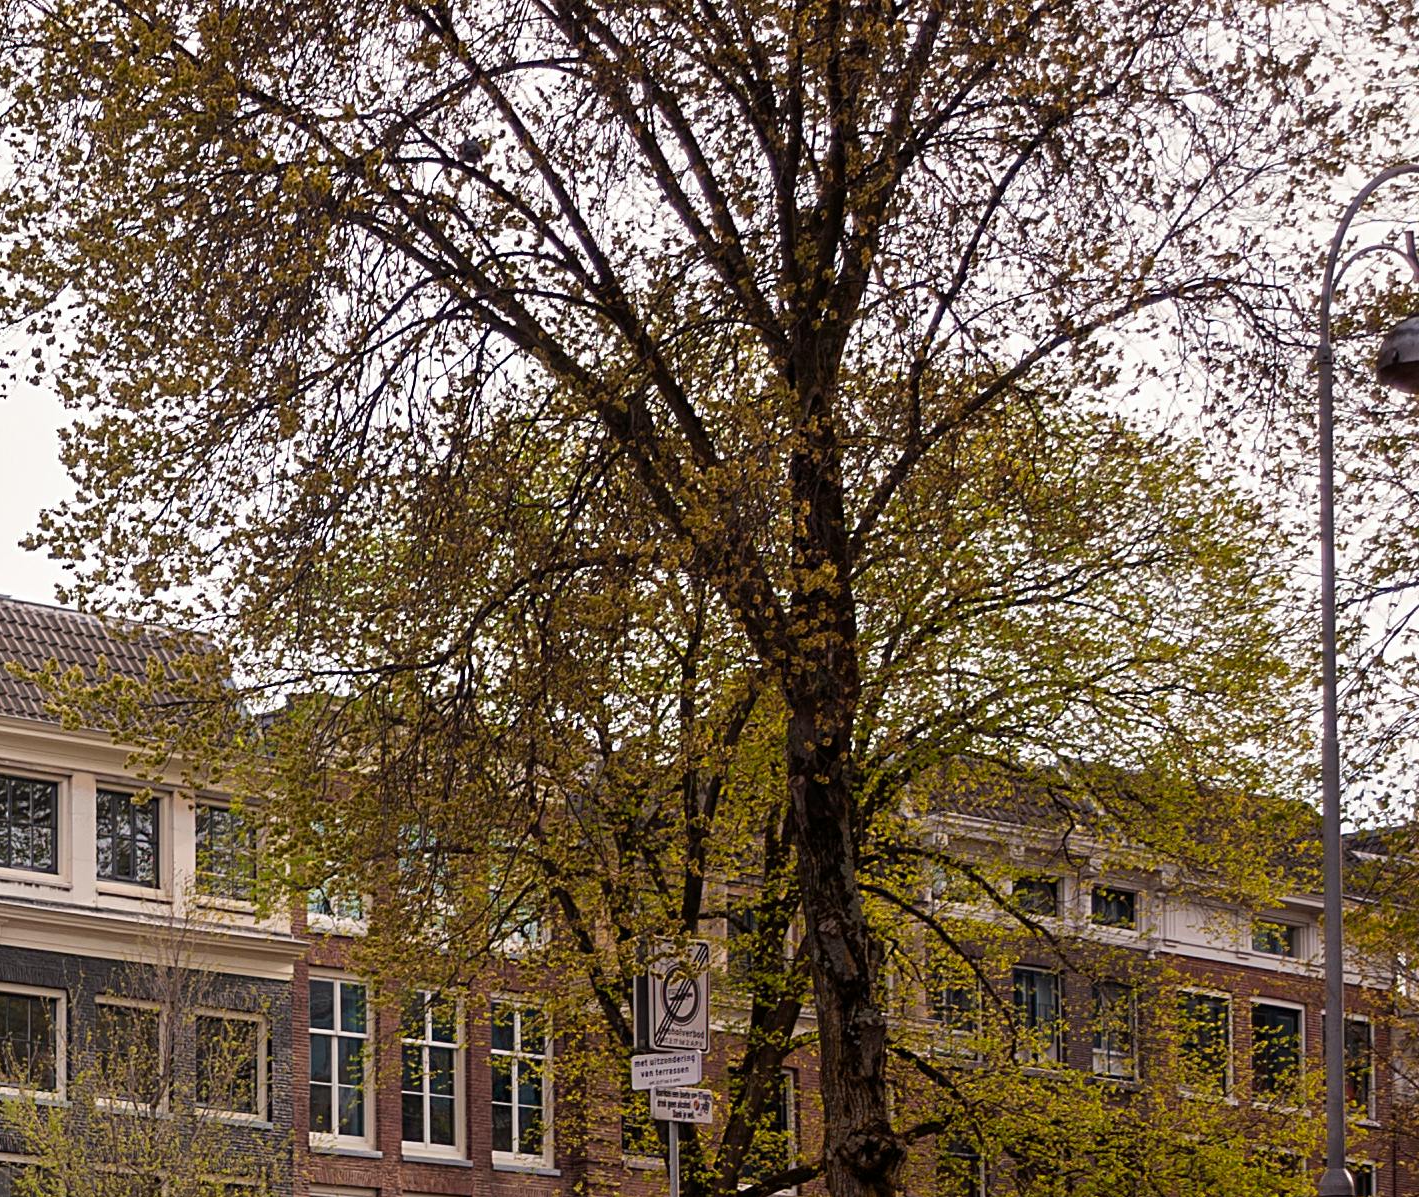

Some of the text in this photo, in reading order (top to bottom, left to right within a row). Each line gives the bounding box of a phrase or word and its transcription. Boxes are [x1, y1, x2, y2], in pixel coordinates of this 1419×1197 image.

[634, 1055, 695, 1067] met uitzondering
[640, 1066, 689, 1078] van terrassen
